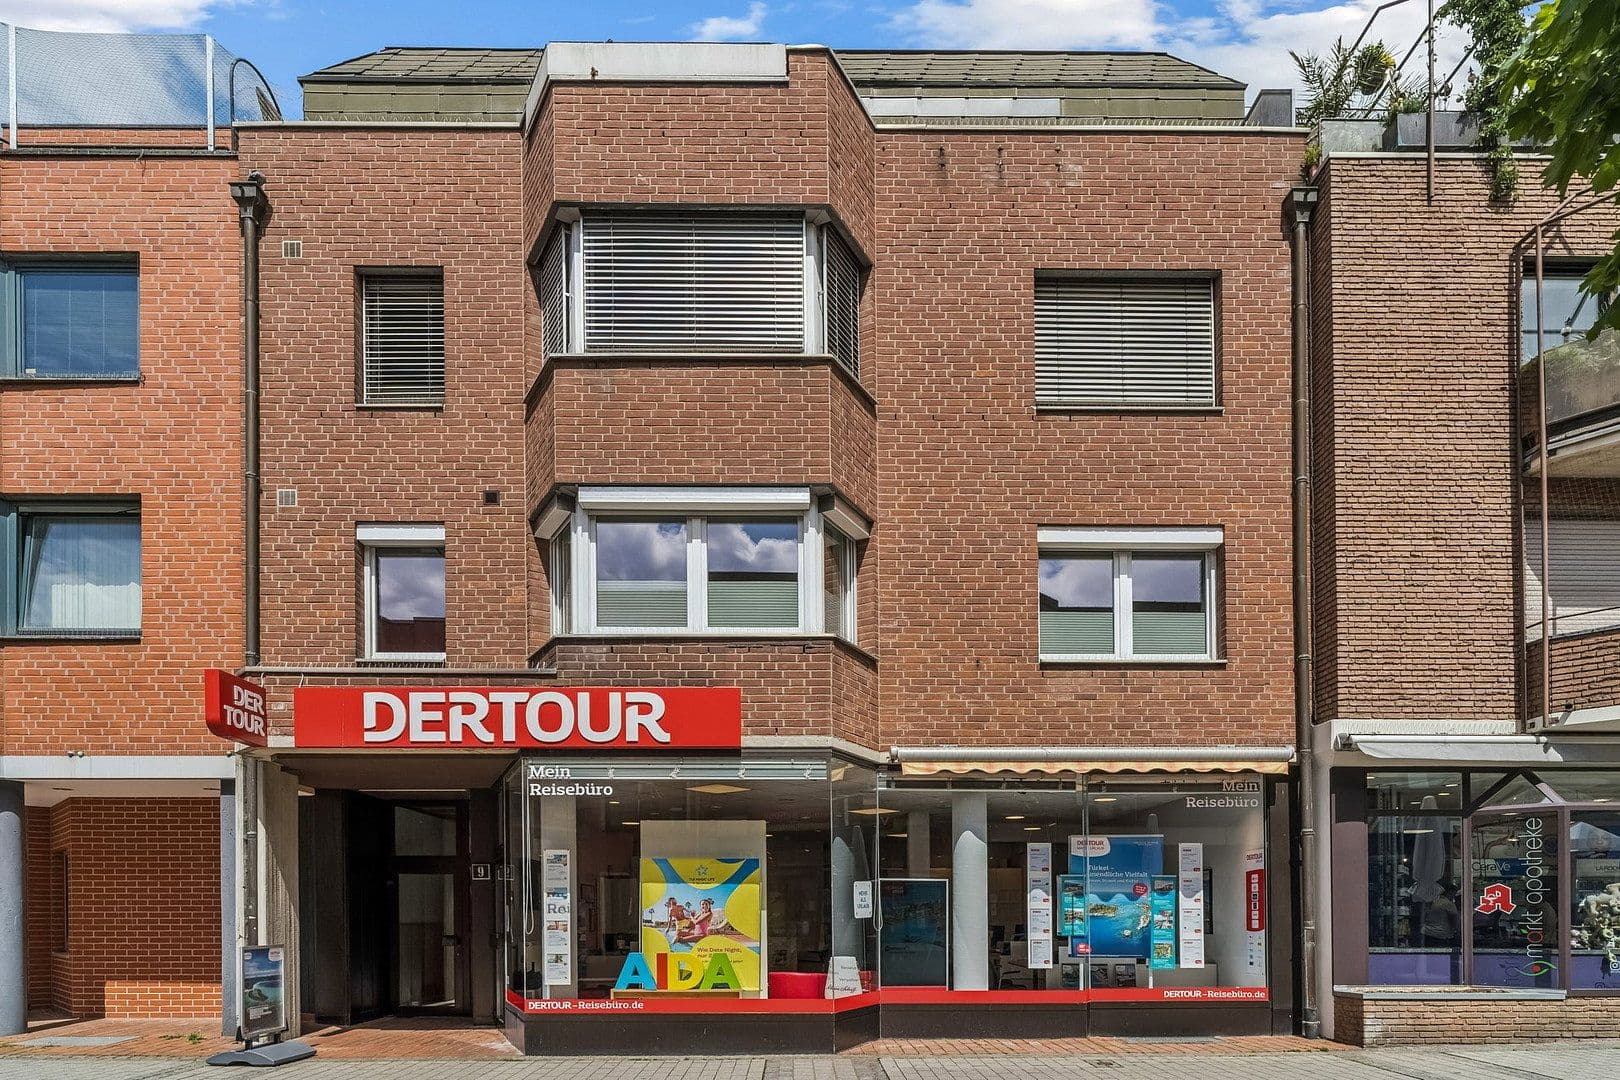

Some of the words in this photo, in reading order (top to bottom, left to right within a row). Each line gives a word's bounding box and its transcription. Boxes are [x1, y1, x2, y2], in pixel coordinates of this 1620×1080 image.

[233, 685, 265, 715] DER
[223, 704, 266, 737] TOUR
[363, 691, 671, 743] DERTOUR
[529, 765, 571, 778] Mein
[530, 783, 613, 796] Reisebüro
[1222, 780, 1259, 791] Mein
[1185, 797, 1259, 808] Reisebüro
[1471, 861, 1511, 872] CeraVe
[1518, 817, 1551, 905] apotheke
[477, 866, 485, 878] 9
[1518, 910, 1543, 958] markt
[614, 952, 741, 991] AIDA
